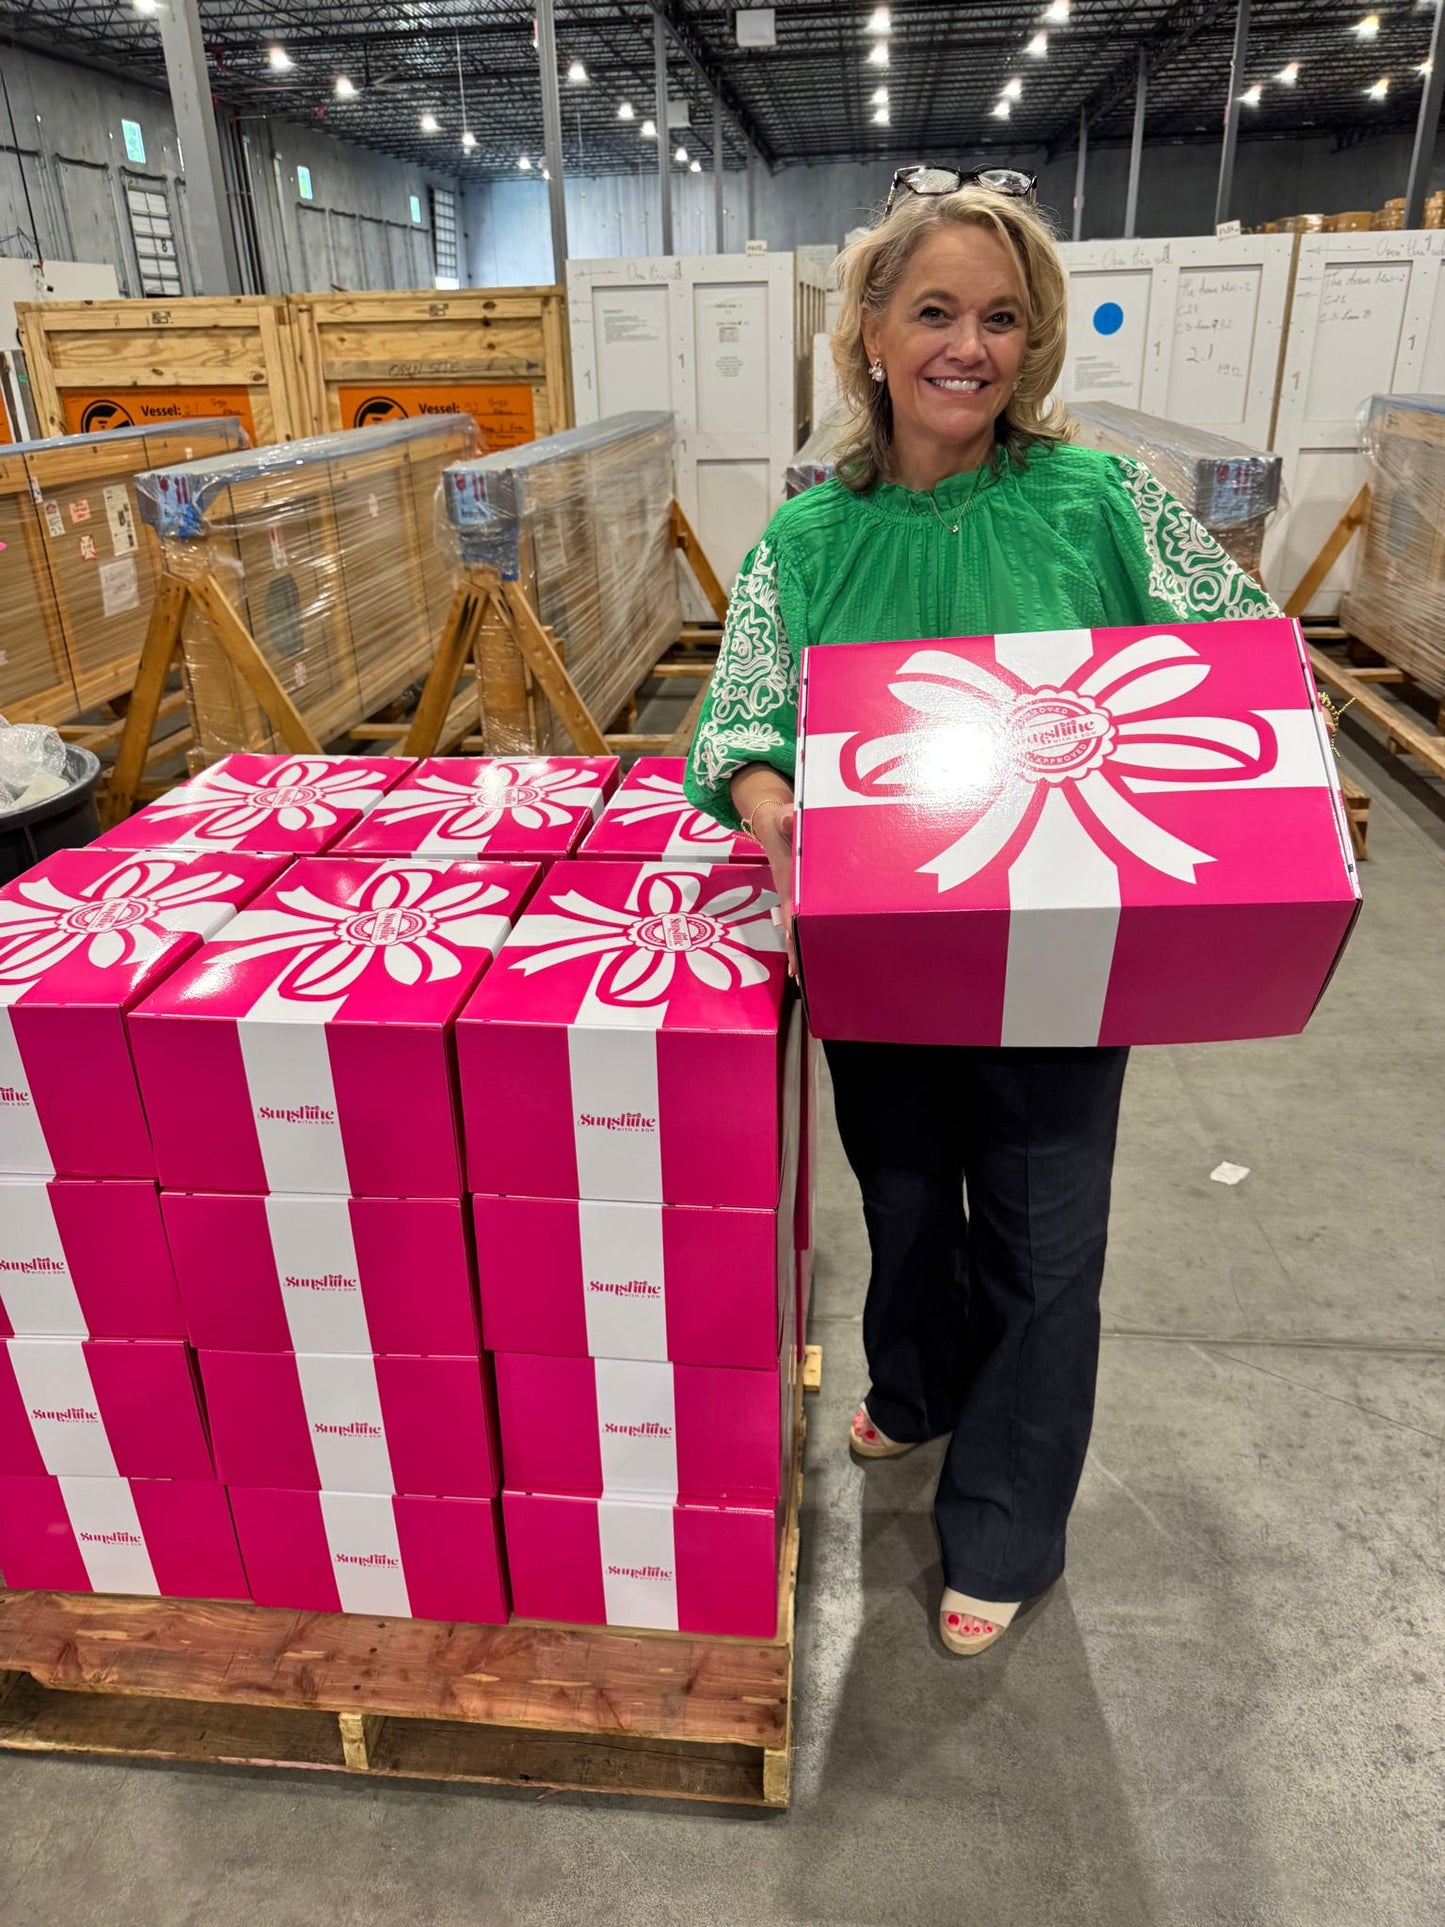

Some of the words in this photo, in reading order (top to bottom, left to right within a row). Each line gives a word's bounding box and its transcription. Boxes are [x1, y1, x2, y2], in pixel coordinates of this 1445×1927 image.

[140, 403, 182, 417] Vessel:
[418, 402, 460, 415] Vessel:
[258, 1104, 335, 1123] Sunshine
[578, 1112, 656, 1130] Sunshine
[284, 1274, 357, 1291] Sunshine
[588, 1280, 661, 1296] Sunshine
[31, 1407, 98, 1422] Sunshine
[313, 1422, 381, 1437] Sunshine
[603, 1422, 672, 1437] Sunshine
